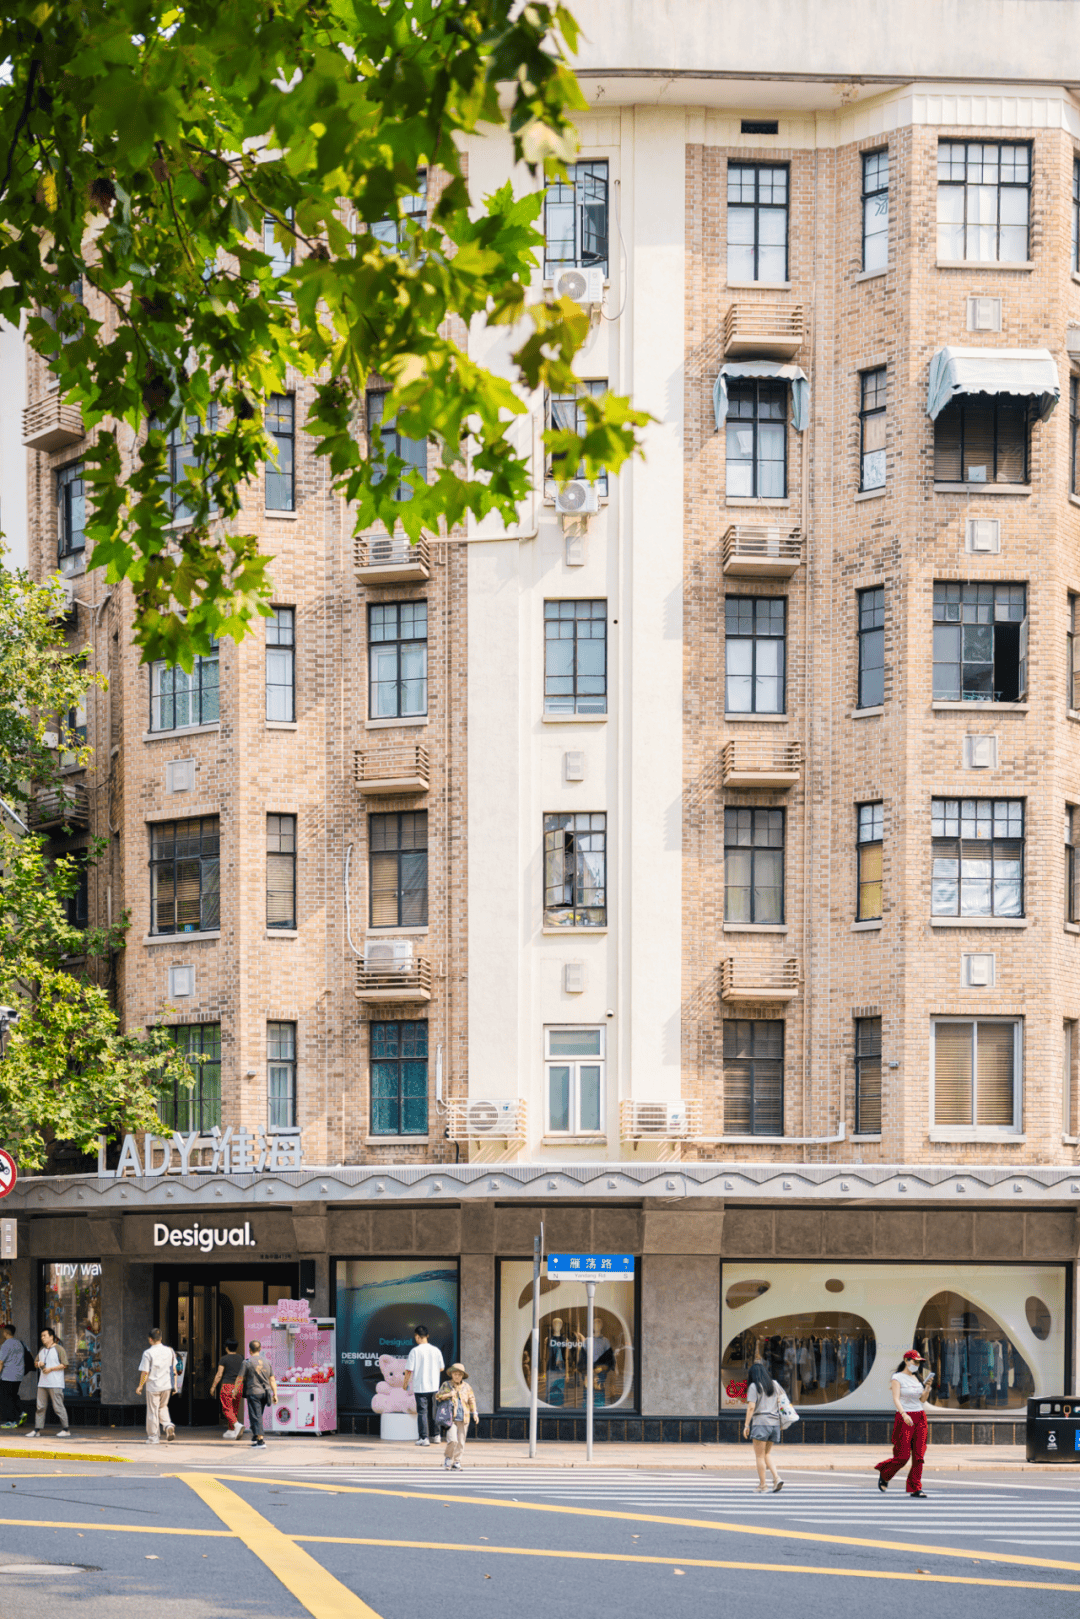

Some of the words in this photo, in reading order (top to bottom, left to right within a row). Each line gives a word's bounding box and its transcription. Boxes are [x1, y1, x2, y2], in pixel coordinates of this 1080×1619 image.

[97, 1132, 200, 1178] LADY
[210, 1124, 304, 1174] 淮海
[154, 1222, 256, 1252] Desigual.
[55, 1263, 78, 1279] tiny
